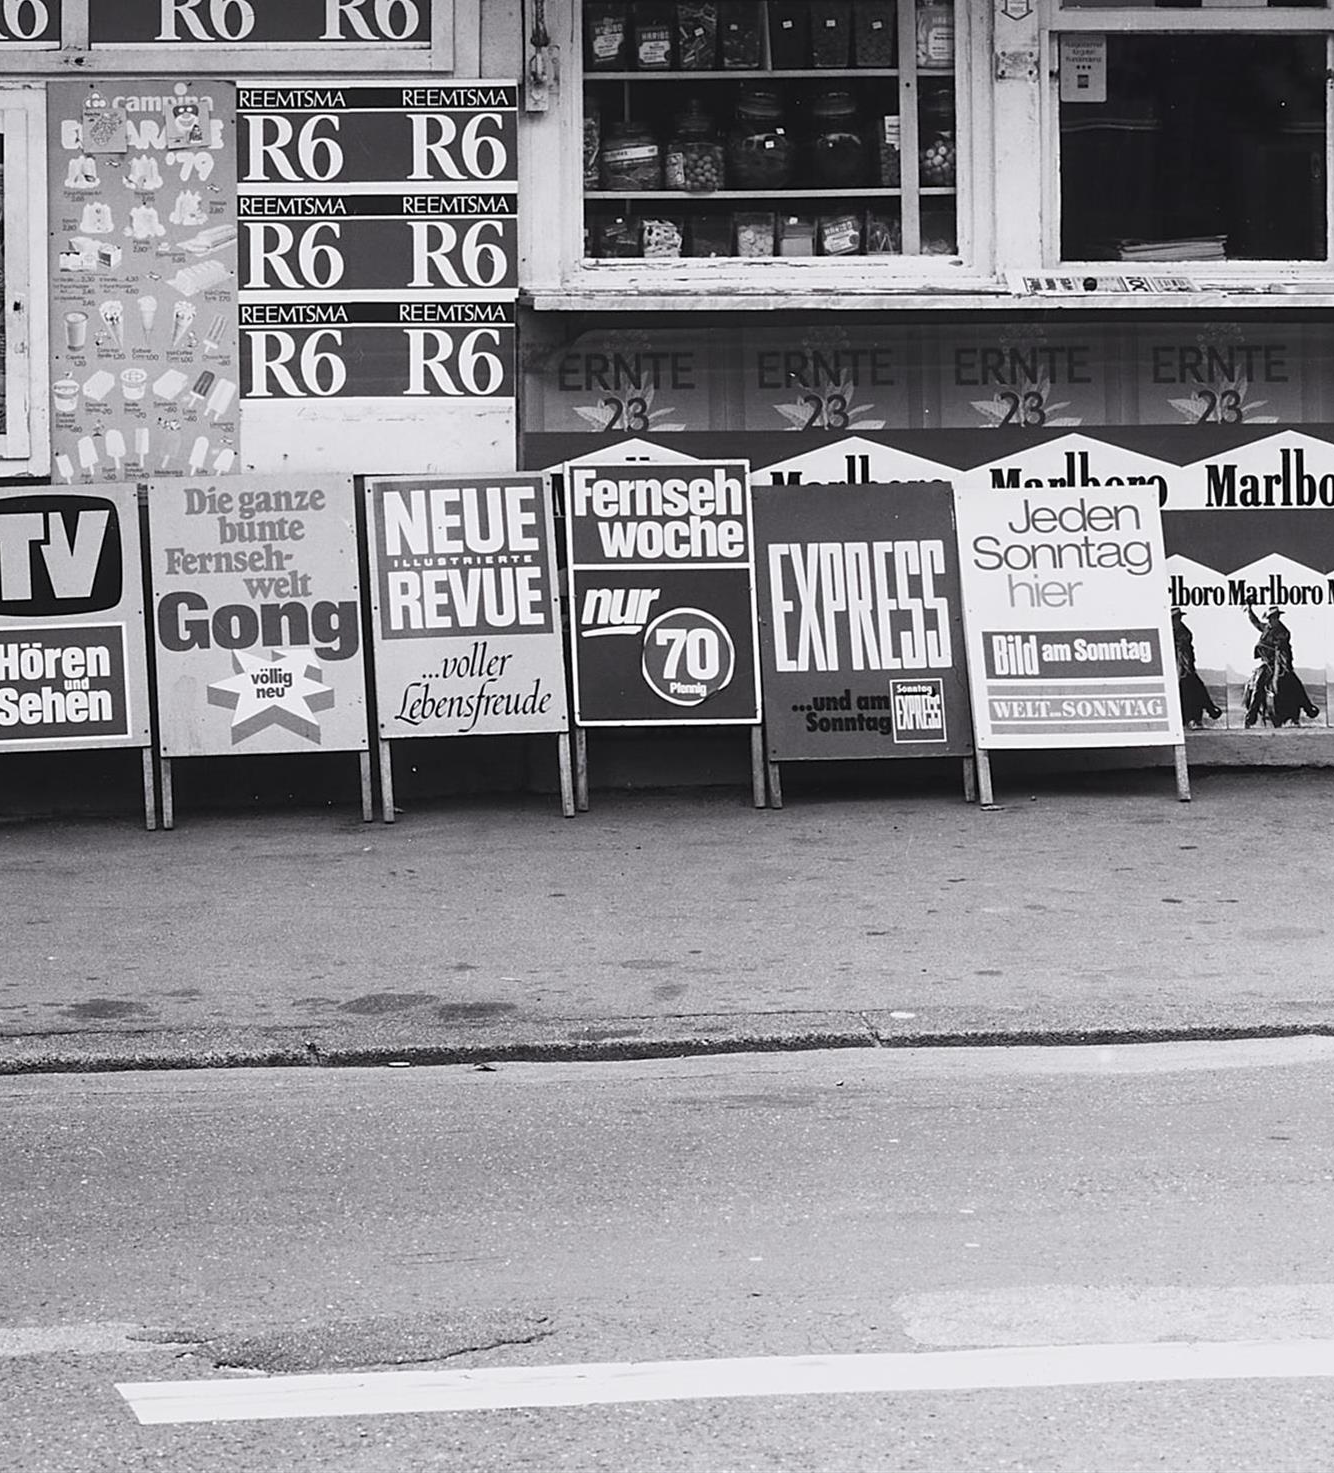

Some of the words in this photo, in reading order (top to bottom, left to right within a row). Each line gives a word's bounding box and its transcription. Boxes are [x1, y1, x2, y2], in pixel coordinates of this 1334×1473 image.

[240, 90, 346, 108] REEMTSMA
[403, 89, 509, 107] REEMTSMA
[243, 113, 344, 182] R6
[407, 112, 507, 181] R6
[240, 197, 347, 215] REEMTSMA
[403, 196, 509, 214] REEMTSMA
[244, 221, 344, 289] R6
[407, 220, 508, 288] R6
[242, 305, 348, 324] REEMTSMA
[399, 303, 506, 322] REEMTSMA
[246, 328, 347, 397] R6
[403, 327, 504, 396] R6
[558, 352, 696, 392] ERNTE
[758, 348, 897, 389] ERNTE
[955, 347, 1092, 387] ERNTE
[1151, 344, 1290, 385] ERNTE
[184, 487, 235, 515] Die
[238, 488, 326, 518] ganze
[574, 468, 743, 518] Fernseh
[218, 516, 305, 544] bunte
[383, 486, 539, 556] NEUE
[1008, 499, 1141, 534] Jeden
[598, 516, 744, 558] woche
[164, 543, 294, 575] Fernseh-
[393, 555, 533, 568] ILLUSTRIERTE
[973, 536, 1154, 575] Sonntag
[242, 572, 312, 599] welt
[388, 566, 545, 630] REVUE
[1008, 574, 1083, 609] hier
[1228, 574, 1323, 606] Marlboro
[581, 587, 661, 626] nur
[768, 539, 954, 673] EXPRESS
[157, 591, 360, 661] Gong
[655, 628, 720, 680] 70
[992, 634, 1040, 676] Bild
[1042, 642, 1072, 661] am
[1074, 637, 1152, 663] Sonntag
[64, 677, 90, 691] und
[251, 669, 293, 688] völlig
[256, 685, 286, 699] neu
[670, 681, 708, 696] Pfennig
[896, 683, 934, 696] Sonntag
[394, 678, 553, 733] Lebensfreude
[857, 695, 890, 711] am
[895, 693, 943, 731] EXPRESS
[992, 700, 1049, 720] WELT
[1061, 697, 1165, 718] SONNTAG
[806, 712, 893, 735] Sonntag
